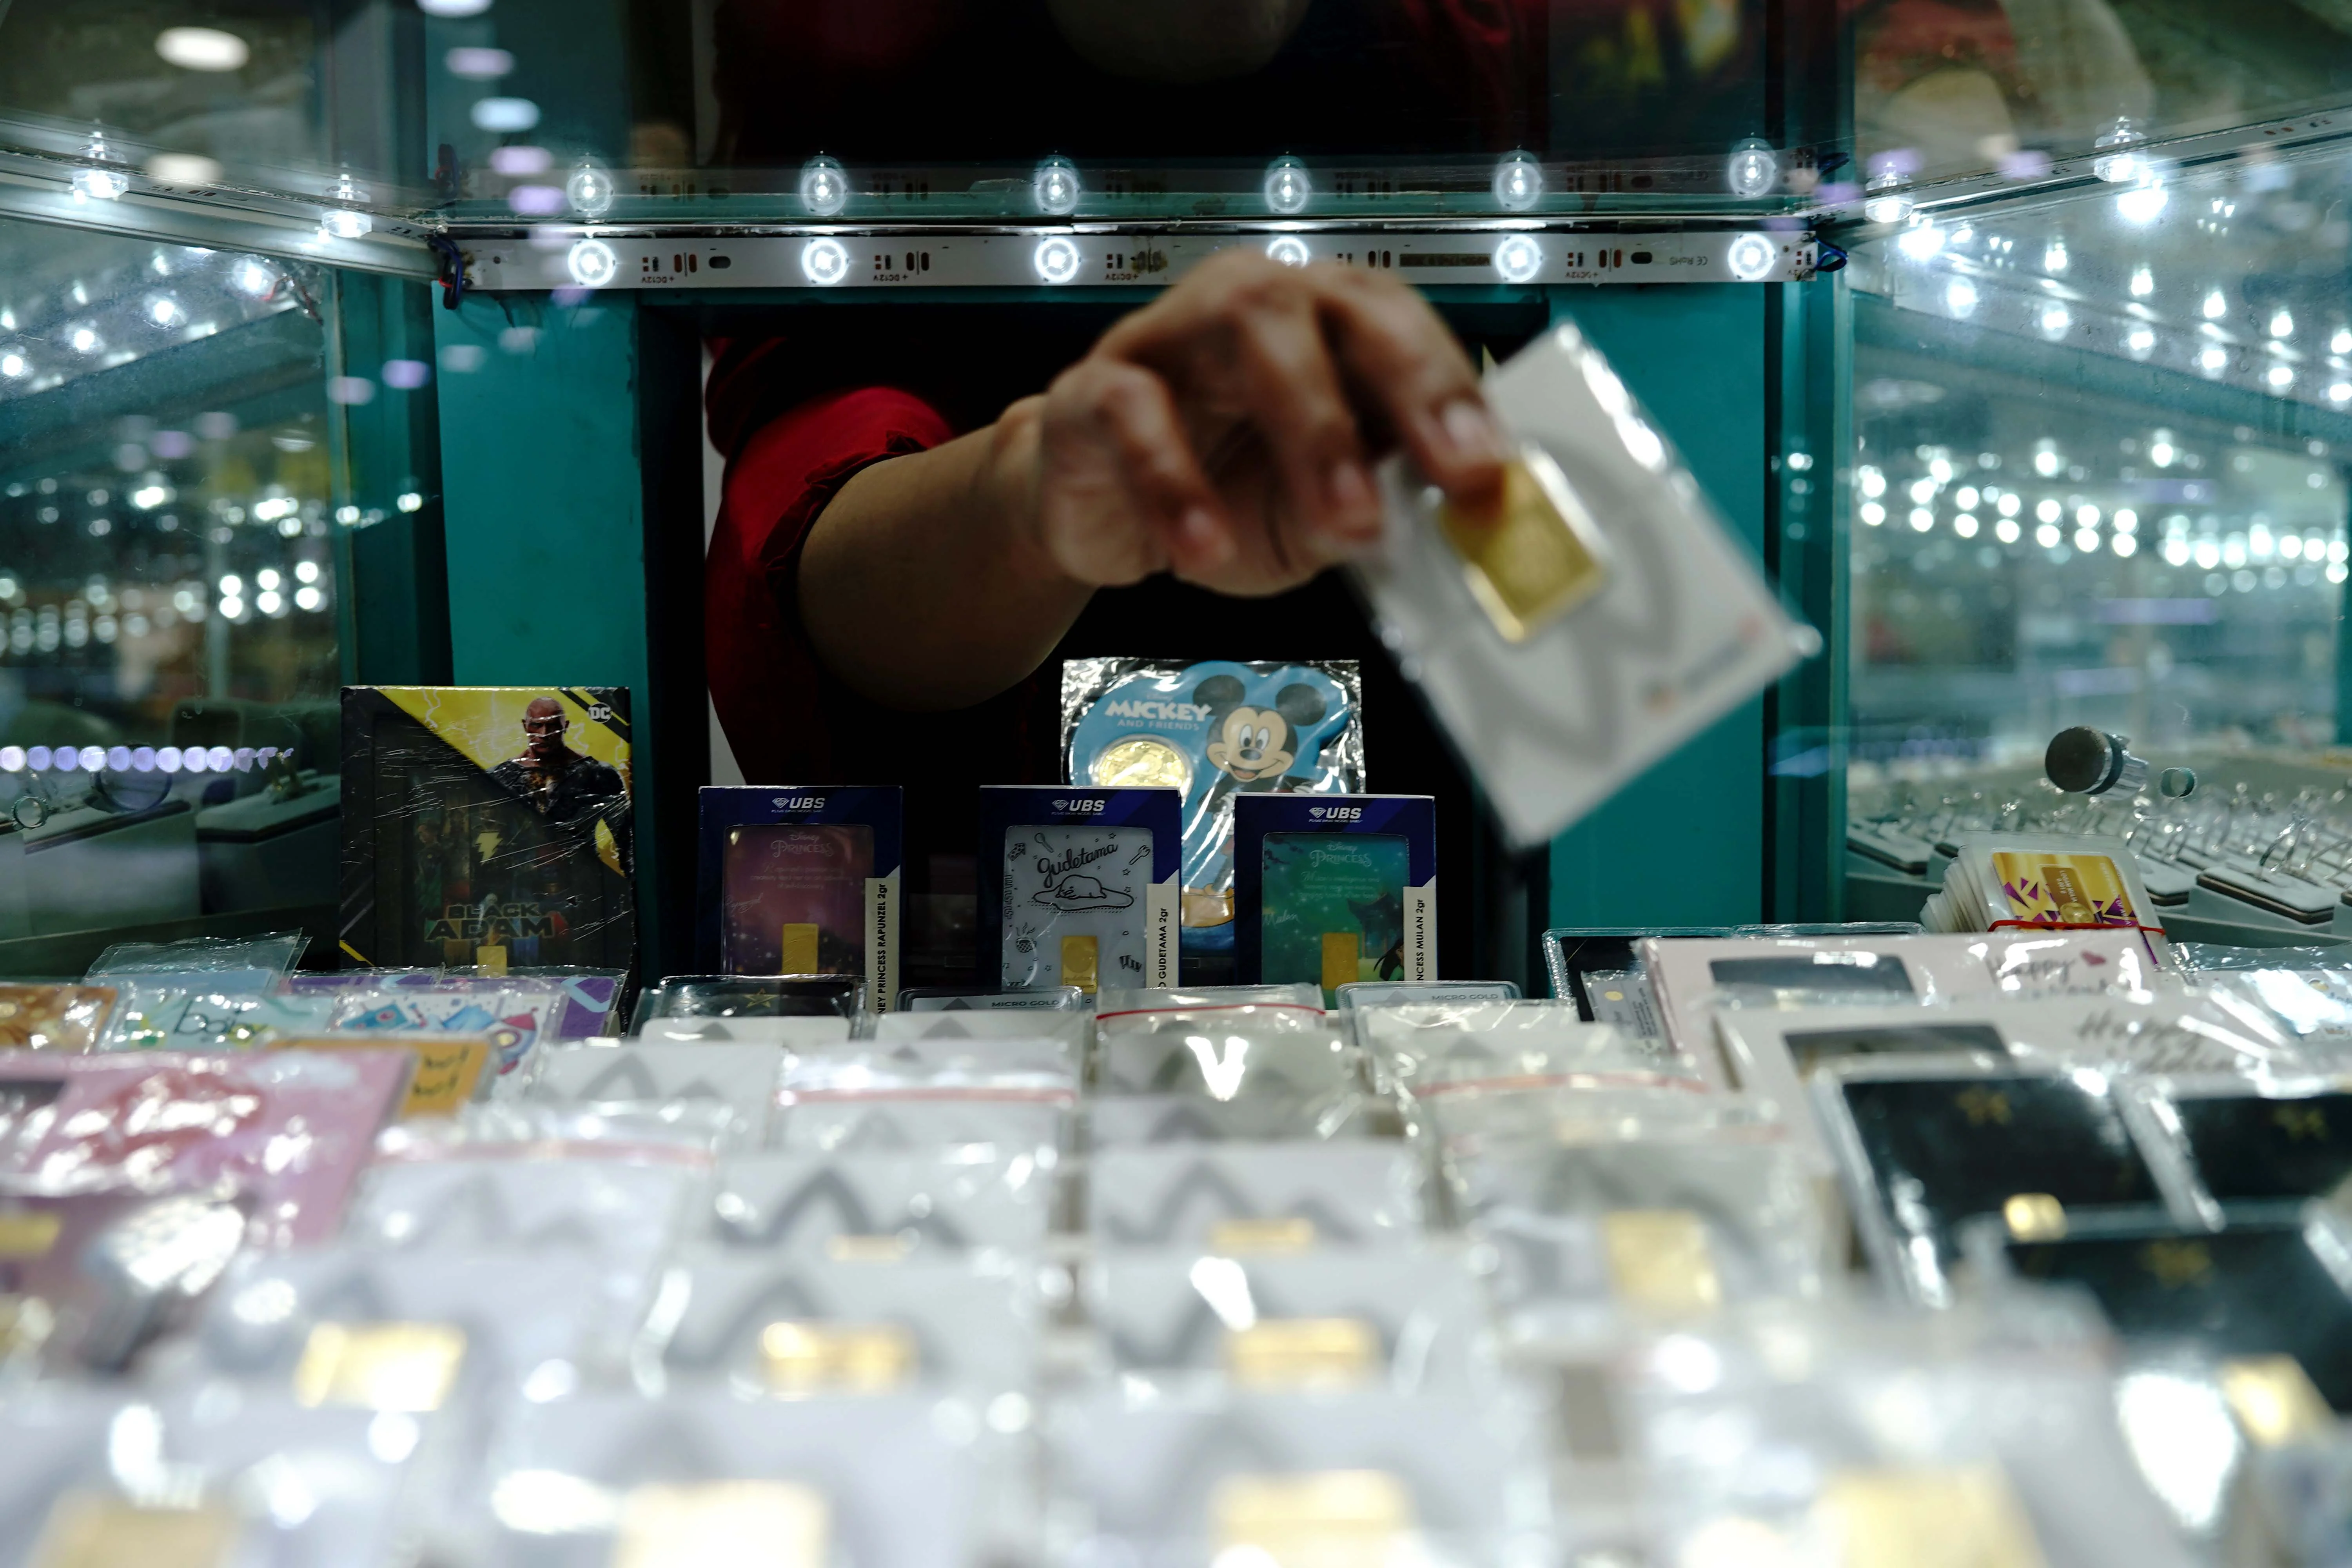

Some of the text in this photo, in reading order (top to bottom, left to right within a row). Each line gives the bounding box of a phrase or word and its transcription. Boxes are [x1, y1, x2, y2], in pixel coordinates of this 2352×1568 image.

[588, 706, 611, 720] DC
[1105, 700, 1212, 721] MICKEY
[1117, 719, 1200, 731] AND FRIENDS
[789, 797, 825, 808] UBS
[1069, 800, 1105, 811] UBS
[1326, 808, 1361, 819] UBS
[771, 840, 834, 858] PRINCESS
[1309, 849, 1372, 868] PRINCESS
[447, 903, 542, 918] BLACK
[1416, 899, 1425, 913] 2gr
[1159, 908, 1169, 922] 2gr
[424, 916, 555, 942] ADAM
[877, 884, 887, 1014] NEY PRINCESS RAPUNZEL 2gr
